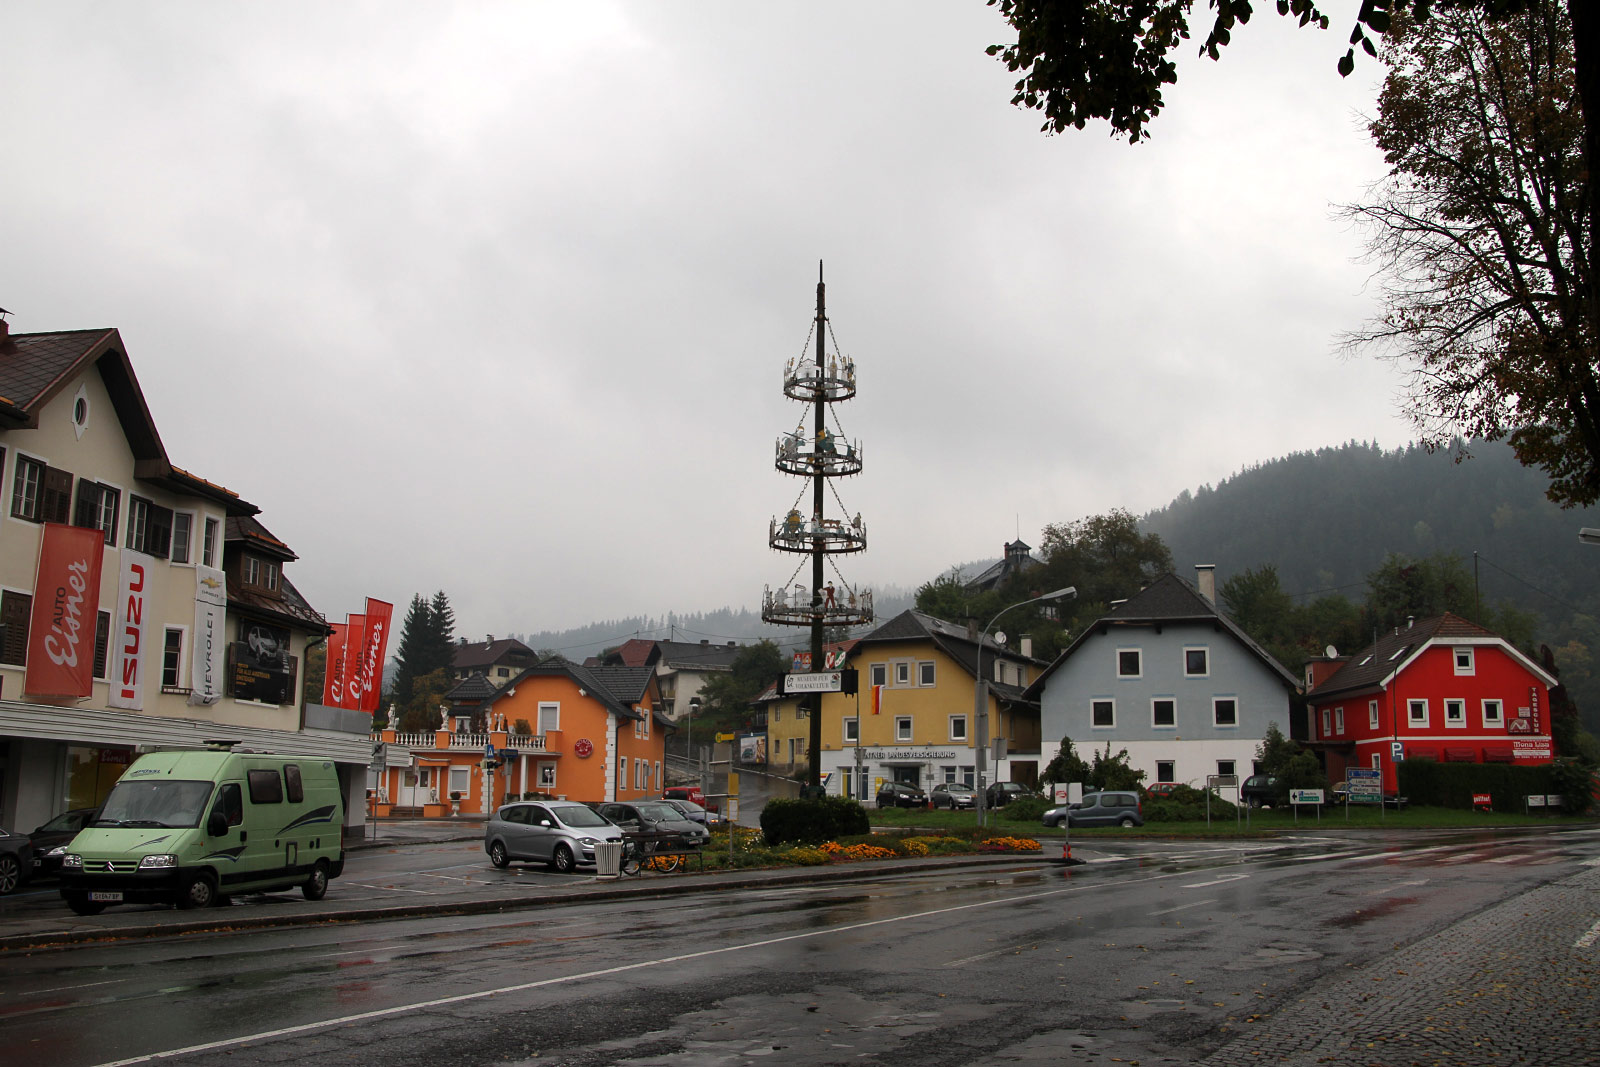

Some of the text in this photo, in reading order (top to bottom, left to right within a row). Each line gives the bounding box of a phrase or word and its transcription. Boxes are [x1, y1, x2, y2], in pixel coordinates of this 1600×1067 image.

[44, 559, 87, 668] Eisner
[53, 586, 66, 626] AUTO
[121, 564, 144, 698] ISUZU
[361, 622, 383, 692] Eisner
[1531, 687, 1539, 733] TAGESCLUB
[888, 751, 955, 760] LANDESVERSICHERUNG
[1391, 742, 1402, 757] P
